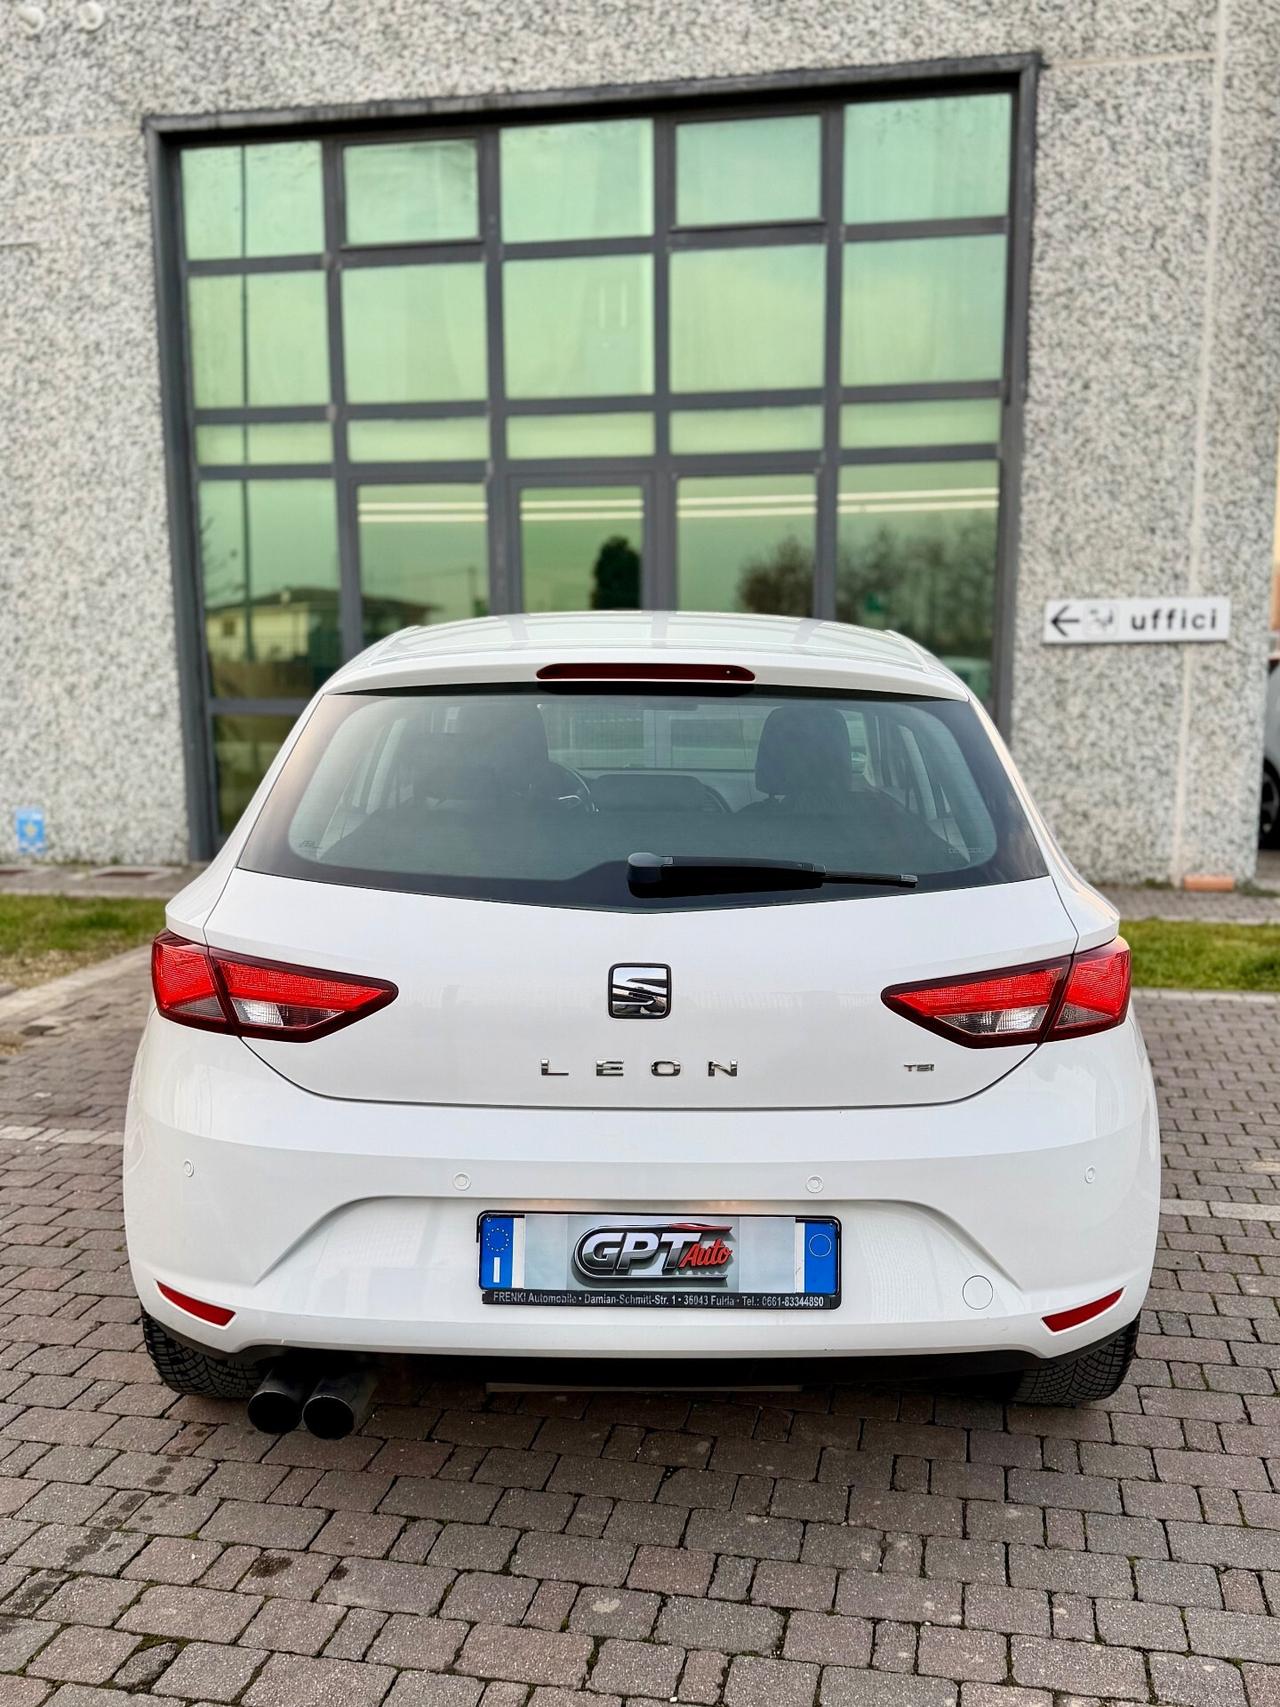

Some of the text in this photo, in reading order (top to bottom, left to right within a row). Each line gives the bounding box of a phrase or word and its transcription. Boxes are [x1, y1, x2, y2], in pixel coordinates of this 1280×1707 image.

[1131, 608, 1217, 631] uffici
[540, 1058, 738, 1077] LEON
[904, 1063, 934, 1072] TSI
[528, 1292, 576, 1304] Automobile
[672, 1295, 676, 1304] 1
[683, 1295, 709, 1306] 36043
[711, 1295, 735, 1306] Fulda
